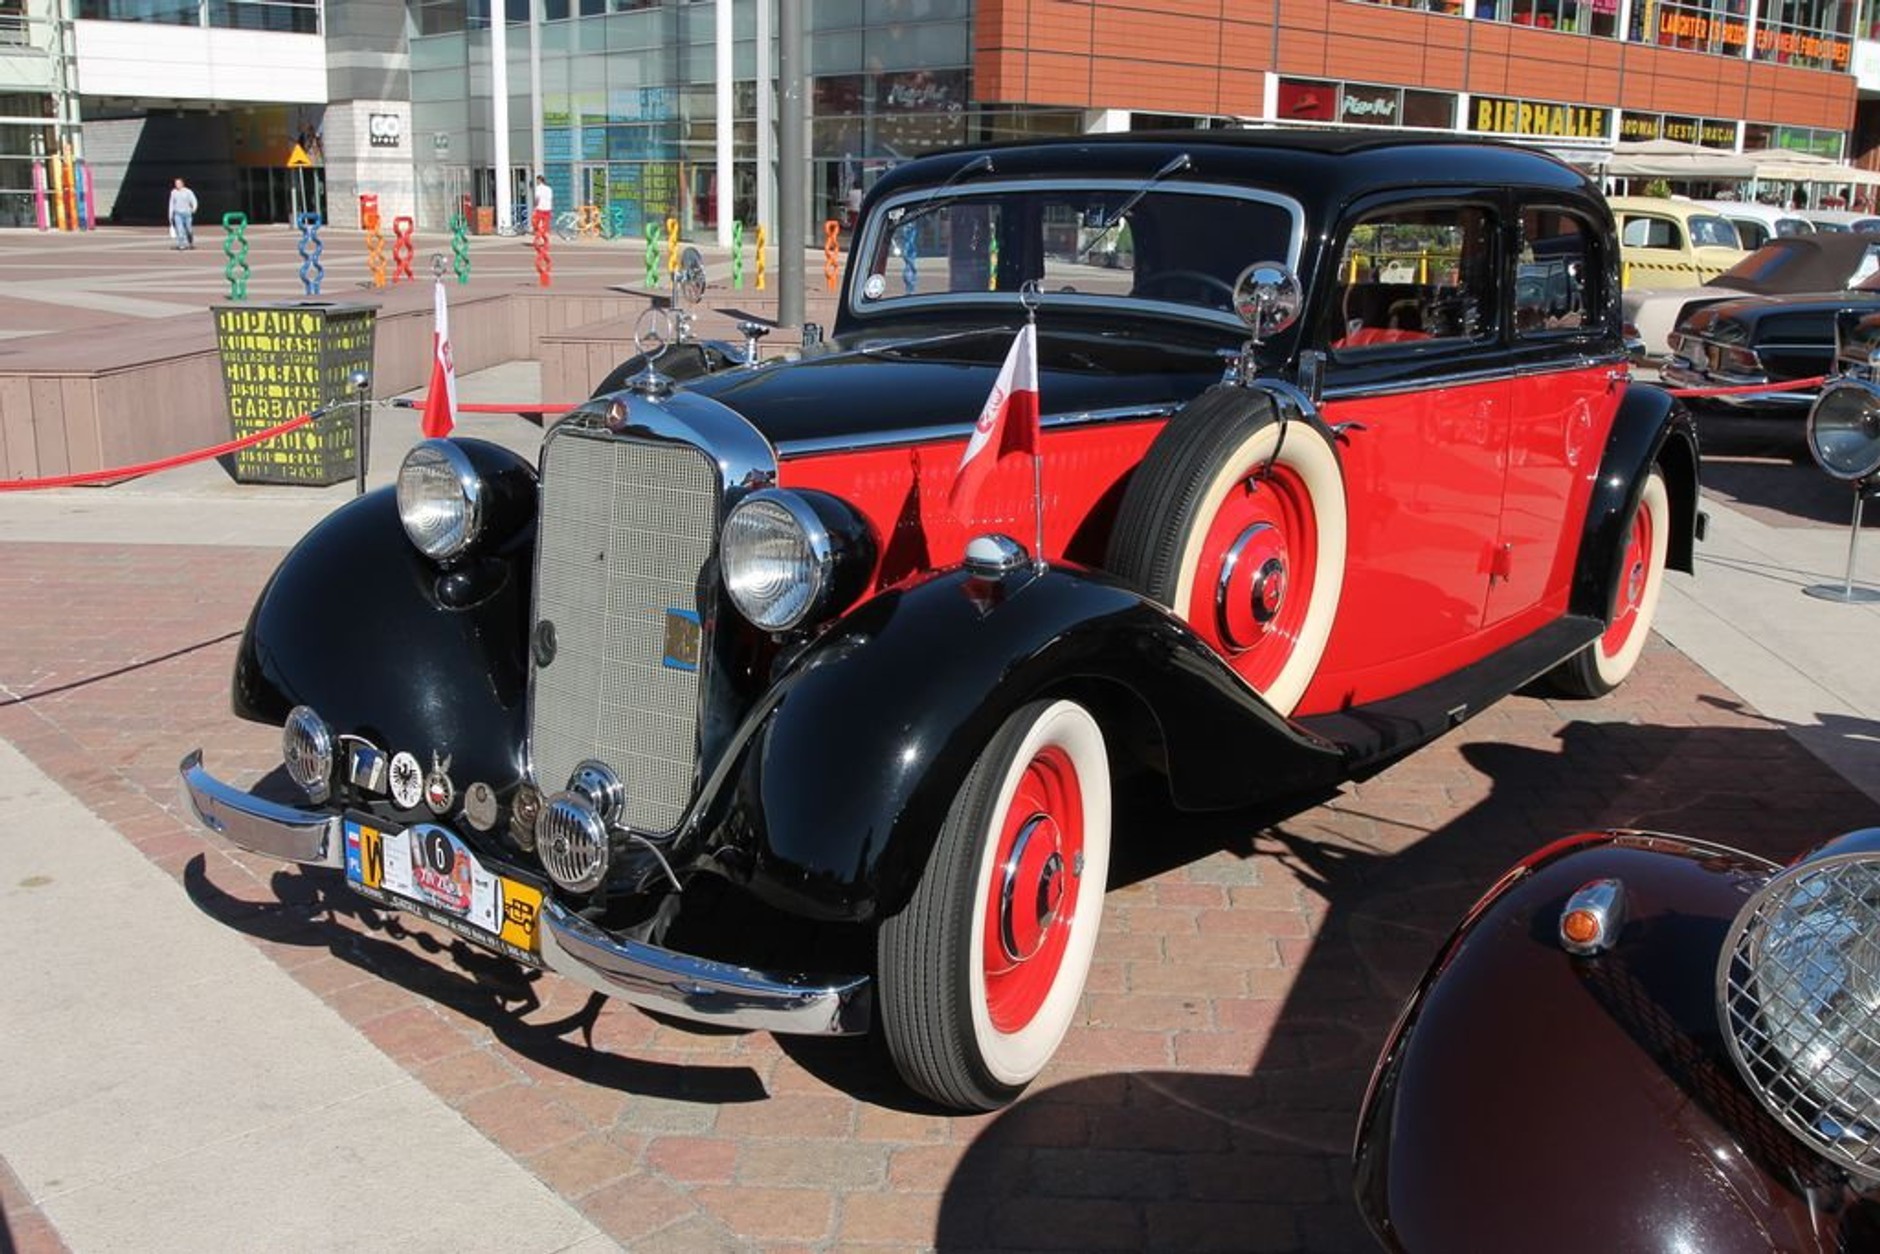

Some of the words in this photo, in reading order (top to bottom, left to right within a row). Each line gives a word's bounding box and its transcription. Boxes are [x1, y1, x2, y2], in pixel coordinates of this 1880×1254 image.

[1477, 99, 1602, 137] BIERHALLE
[231, 398, 320, 419] GARBAGE
[434, 836, 446, 869] 6
